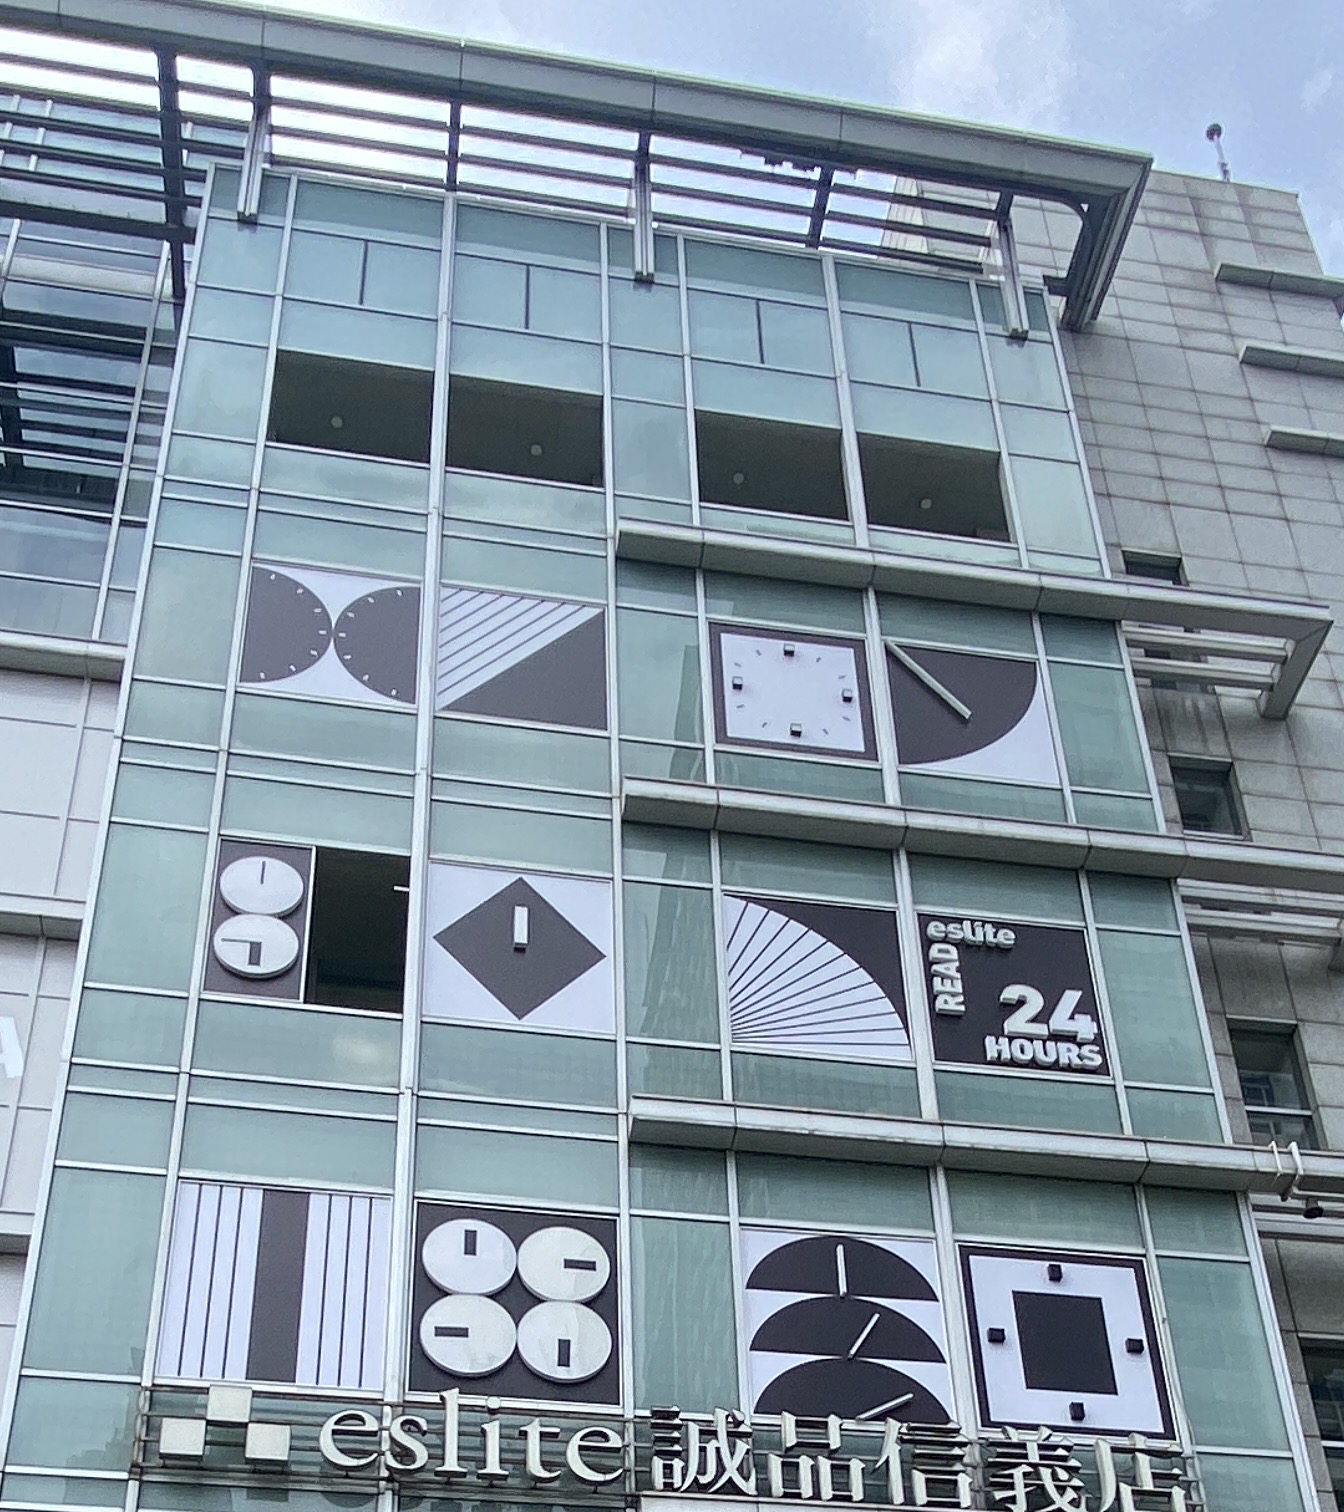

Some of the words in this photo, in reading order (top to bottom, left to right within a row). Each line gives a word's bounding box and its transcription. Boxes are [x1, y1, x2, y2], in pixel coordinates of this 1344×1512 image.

[926, 920, 1016, 949] eslite
[929, 942, 966, 1016] READ
[999, 984, 1098, 1043] 24
[984, 1035, 1103, 1069] HOURS
[319, 1388, 624, 1485] eslite
